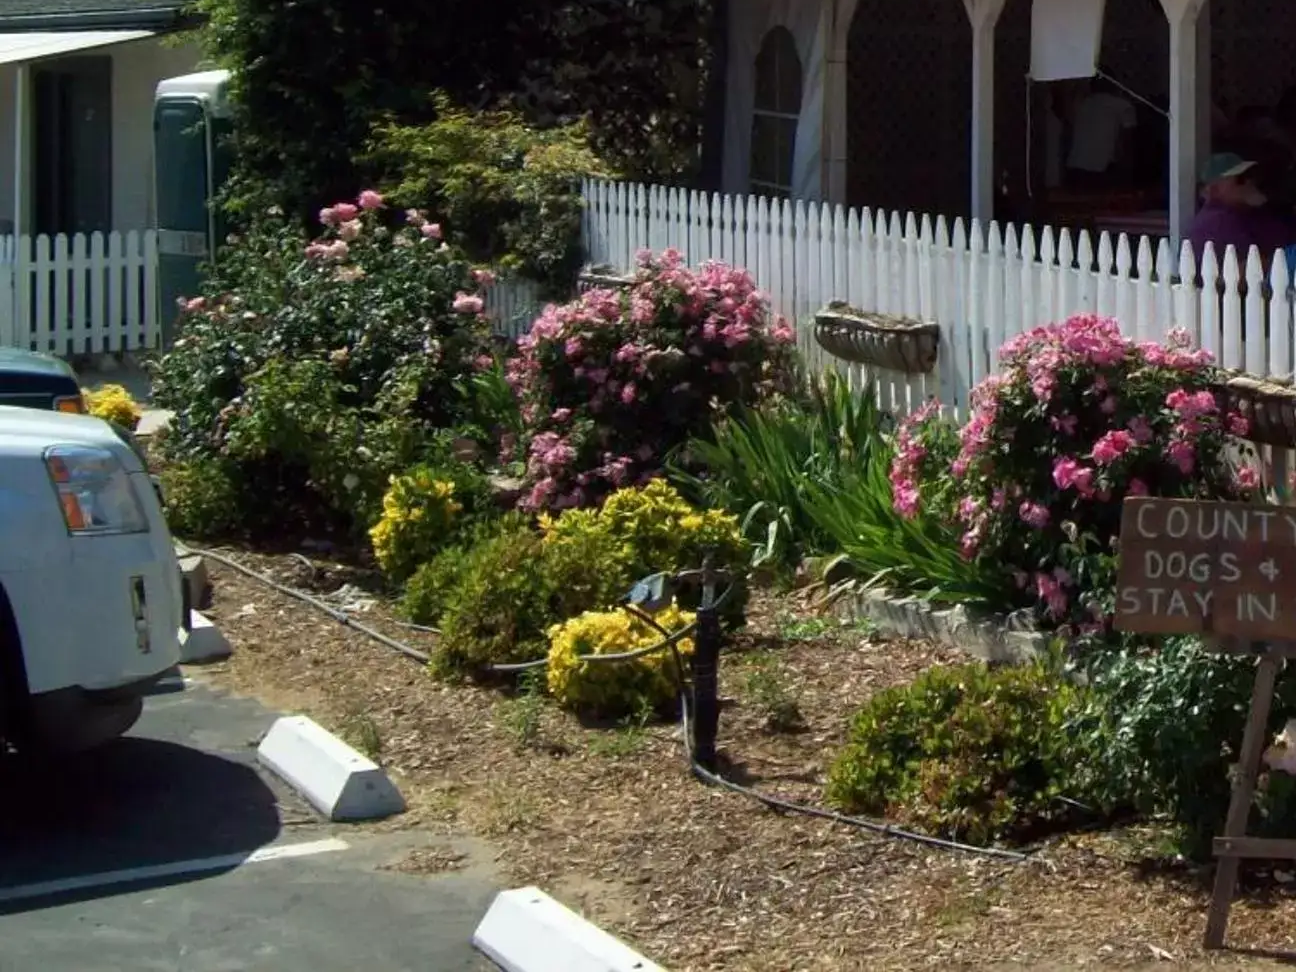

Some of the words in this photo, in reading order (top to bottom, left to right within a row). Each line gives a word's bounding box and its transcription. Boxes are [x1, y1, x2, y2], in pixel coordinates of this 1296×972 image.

[1144, 550, 1242, 583] DOGS
[1120, 587, 1214, 619] STAY
[1236, 593, 1277, 622] IN
